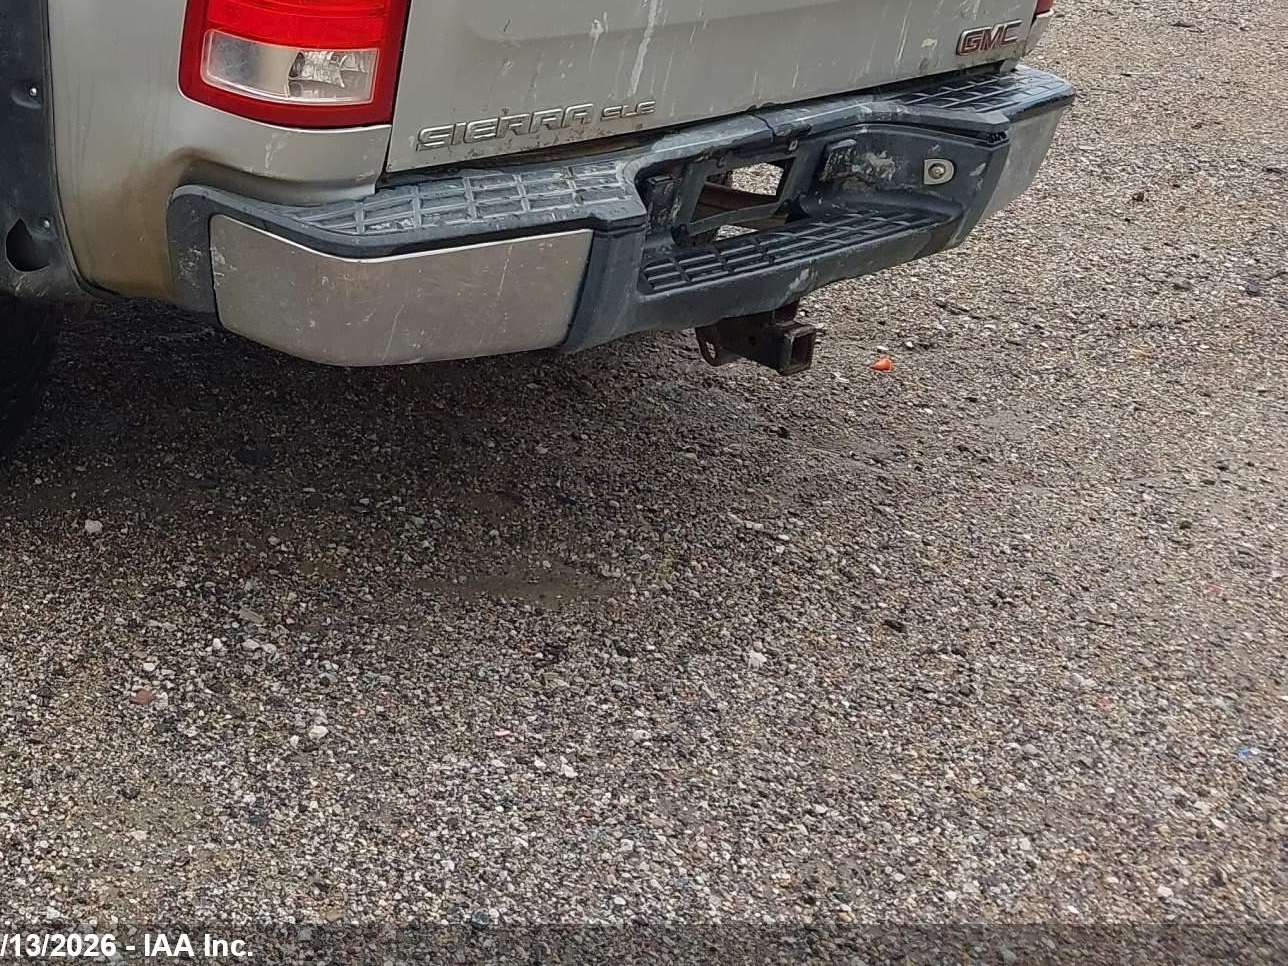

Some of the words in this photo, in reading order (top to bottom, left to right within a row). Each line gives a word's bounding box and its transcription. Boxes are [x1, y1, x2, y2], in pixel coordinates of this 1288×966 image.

[956, 19, 1022, 56] GMC
[416, 103, 594, 151] SIERRA
[600, 100, 656, 122] SLE
